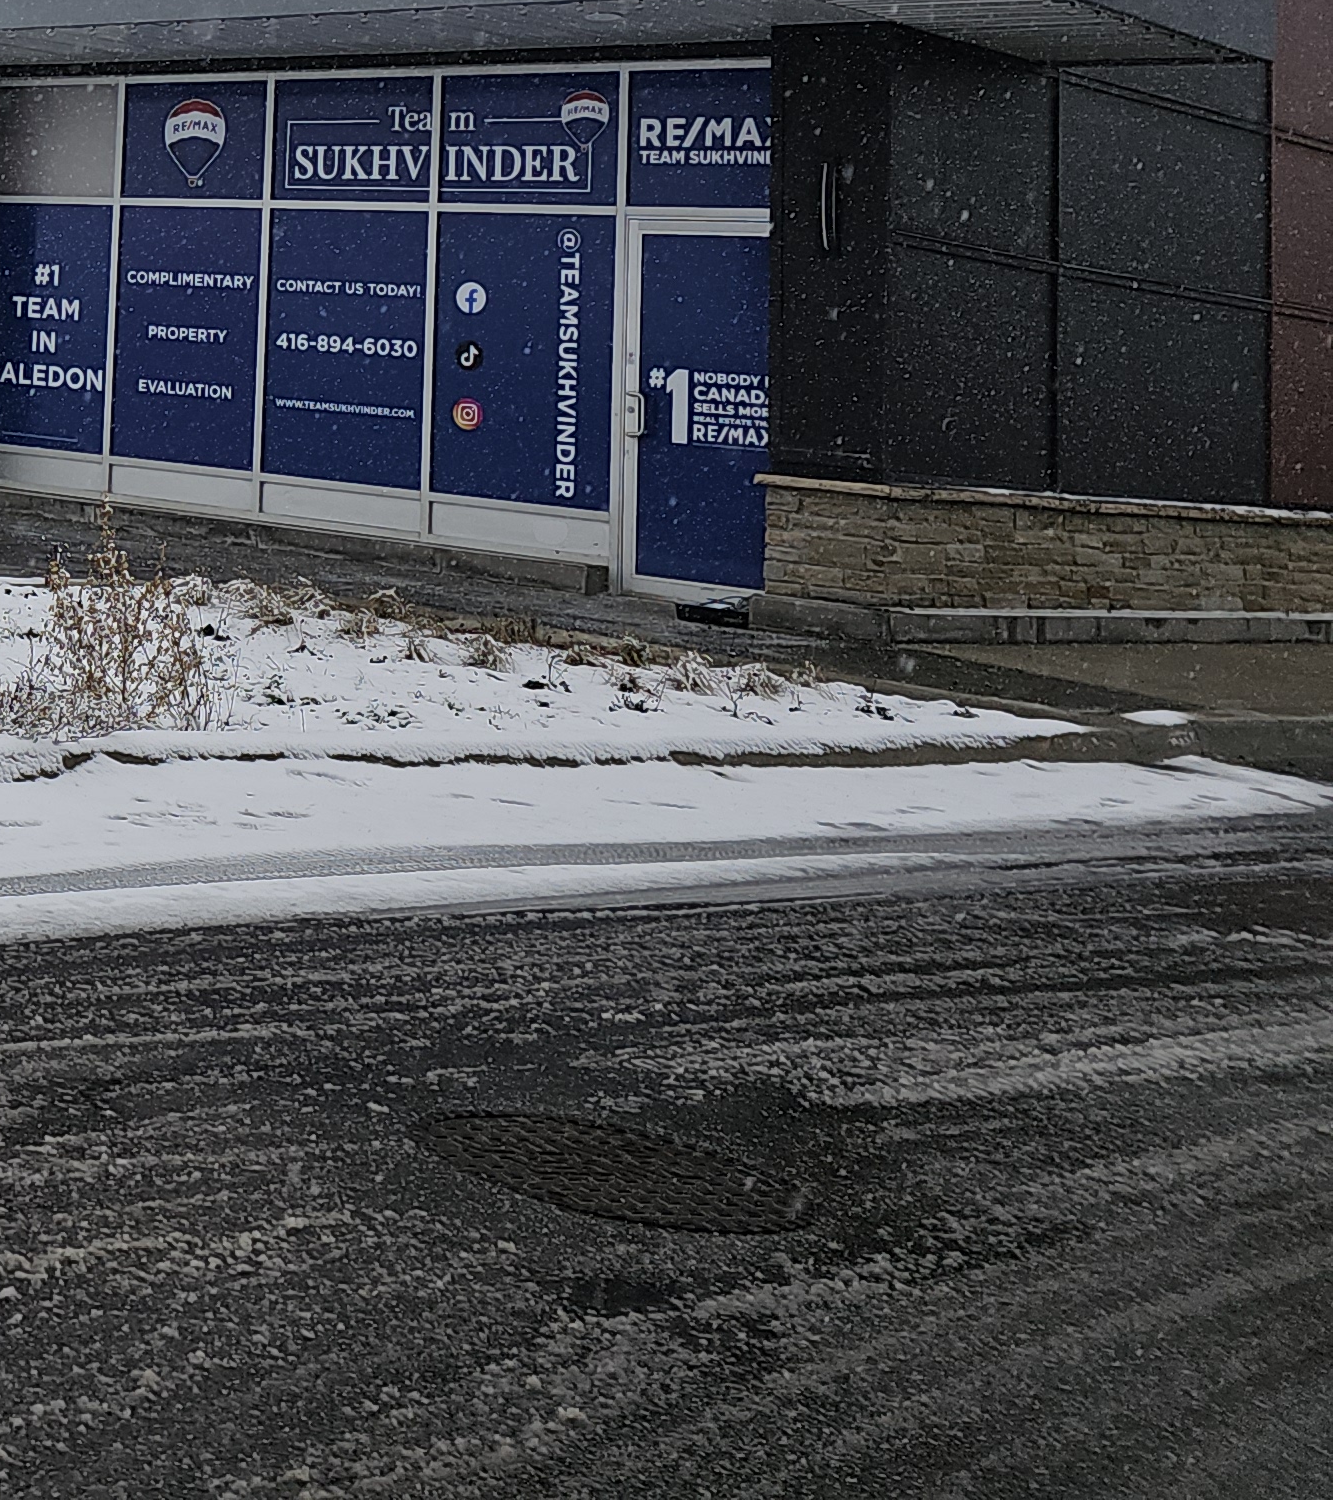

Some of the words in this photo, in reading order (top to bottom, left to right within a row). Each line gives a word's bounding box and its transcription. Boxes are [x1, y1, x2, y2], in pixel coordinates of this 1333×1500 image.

[387, 106, 476, 131] Team
[567, 104, 603, 116] RE/MAX
[172, 120, 218, 135] RE/MAX
[639, 117, 771, 147] RE/MA
[294, 145, 580, 181] SUKHVINDER
[639, 150, 685, 164] TEAM
[689, 150, 771, 164] SUKHVIN
[35, 264, 60, 287] #1
[127, 271, 254, 289] COMPLIMENTARY
[276, 279, 342, 294] CONTACT
[345, 283, 364, 294] US
[367, 284, 421, 297] TODAY!
[12, 296, 80, 321] TEAM
[31, 330, 56, 353] IN
[148, 325, 227, 343] PROPERTY
[276, 333, 418, 358] 416-894-6030
[555, 229, 581, 499] @TEAMSUKHVINDER
[138, 379, 232, 399] EVALUATION
[693, 372, 761, 386] NOBODY
[275, 398, 415, 418] WWW.TEAMSUKHVINDER.COM
[649, 367, 689, 444] #1
[693, 403, 735, 415] SELLS
[738, 406, 769, 417] MOR
